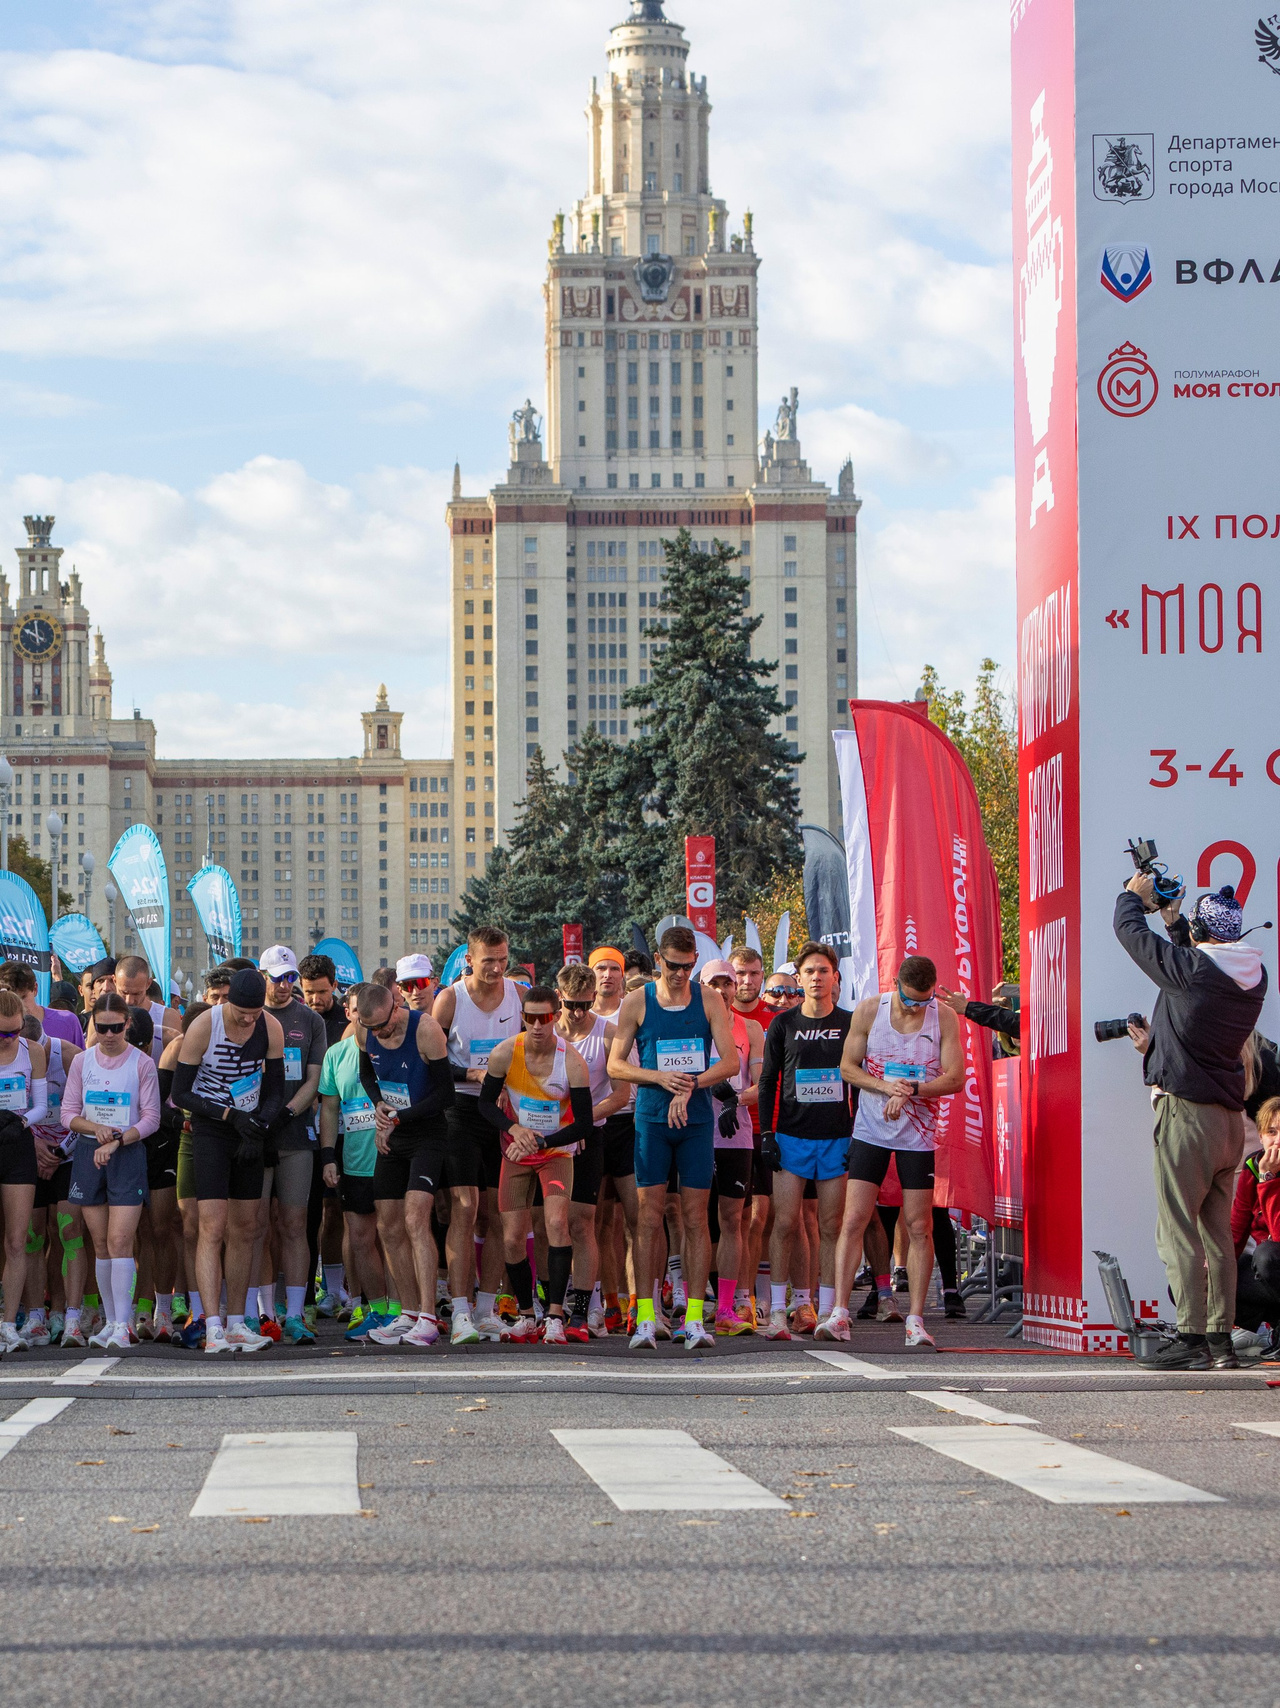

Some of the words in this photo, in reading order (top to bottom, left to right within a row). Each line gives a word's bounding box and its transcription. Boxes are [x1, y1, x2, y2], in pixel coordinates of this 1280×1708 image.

[1168, 159, 1232, 177] спорта
[1169, 181, 1234, 199] города
[1174, 369, 1260, 379] ПОЛУМАРАФОН
[1173, 383, 1221, 398] МОЯ
[1168, 514, 1200, 539] IX
[1149, 749, 1244, 788] 3-4
[693, 886, 708, 903] C
[794, 1029, 841, 1041] NIKE
[663, 1056, 694, 1067] 21635
[801, 1085, 834, 1096] 24426
[239, 1090, 260, 1108] 2387
[384, 1093, 408, 1106] 23384
